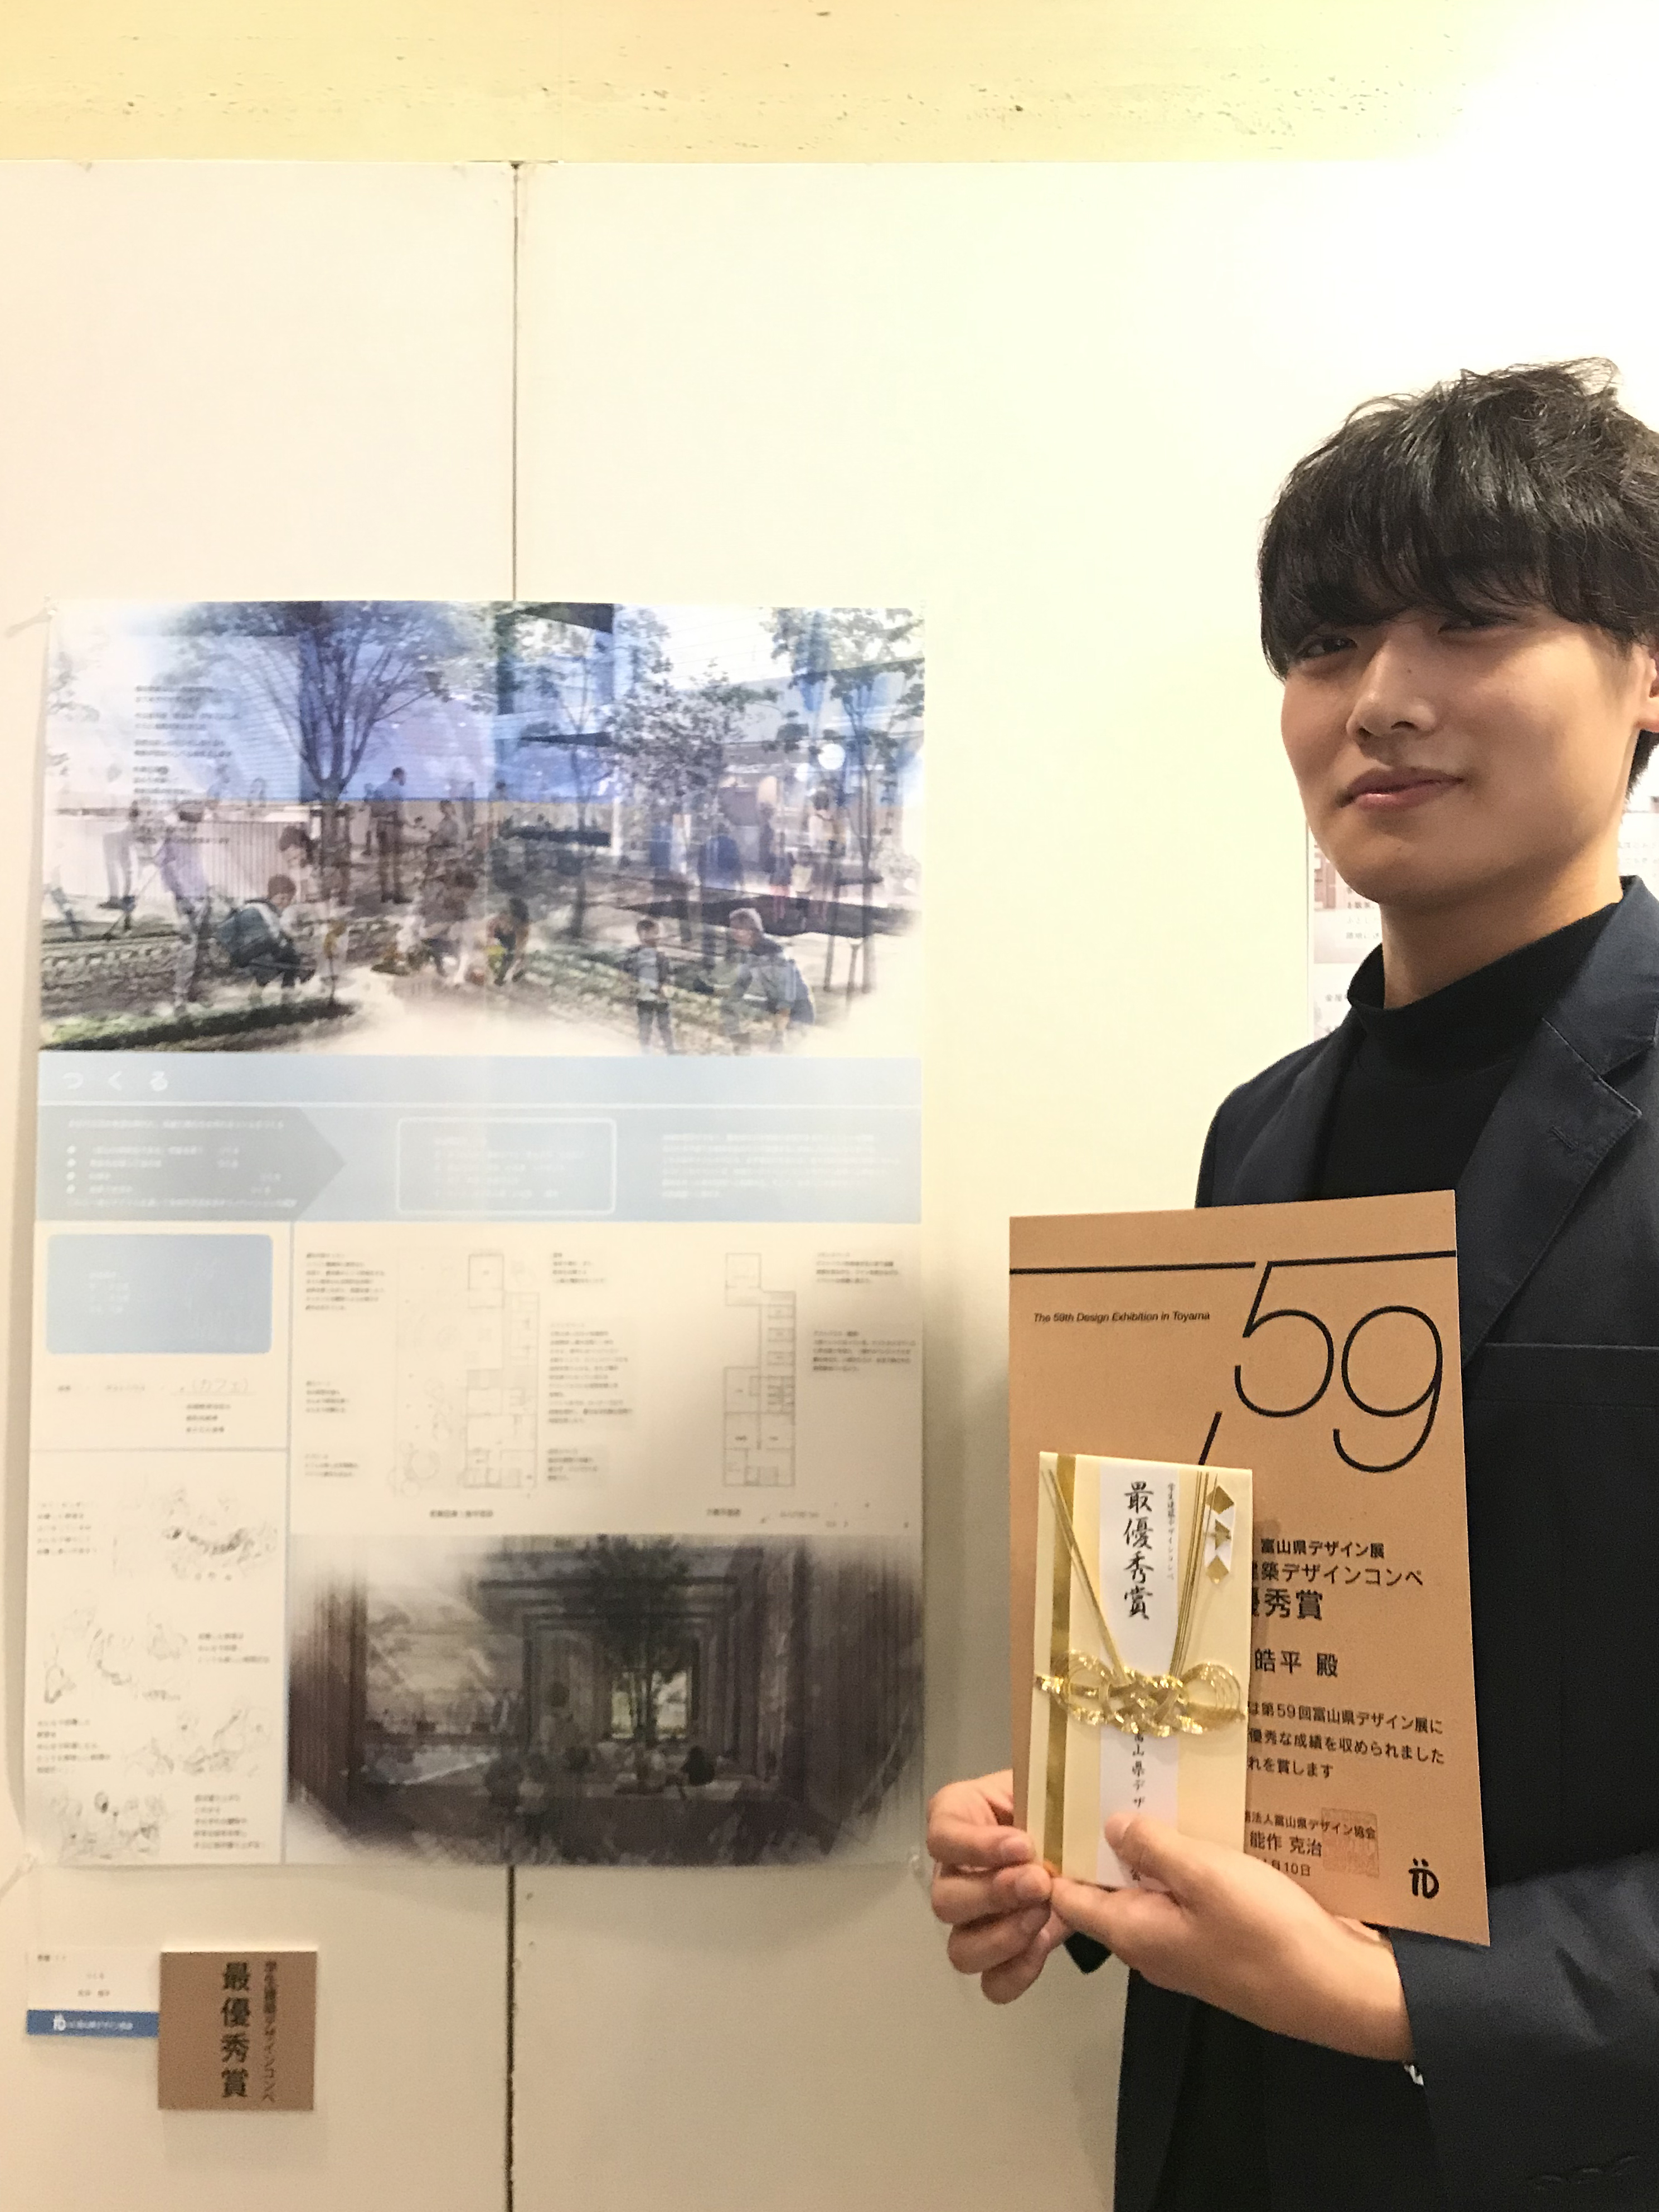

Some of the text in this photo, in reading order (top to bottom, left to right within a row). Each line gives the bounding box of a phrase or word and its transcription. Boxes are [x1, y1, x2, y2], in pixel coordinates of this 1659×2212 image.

[1034, 1313, 1051, 1322] The
[1076, 1312, 1109, 1323] Design
[1112, 1311, 1158, 1321] Exhibition
[1161, 1311, 1170, 1321] in
[1173, 1310, 1210, 1323] Toyama
[1234, 1260, 1443, 1473] 59
[1123, 1481, 1154, 1620] 最優秀賞
[1261, 1539, 1384, 1559] 富山県デザイン展
[1252, 1587, 1323, 1620] 秀賞
[1317, 1652, 1338, 1677] 殿
[1289, 1835, 1322, 1857] 克治
[221, 1962, 250, 2098] 最優秀賞
